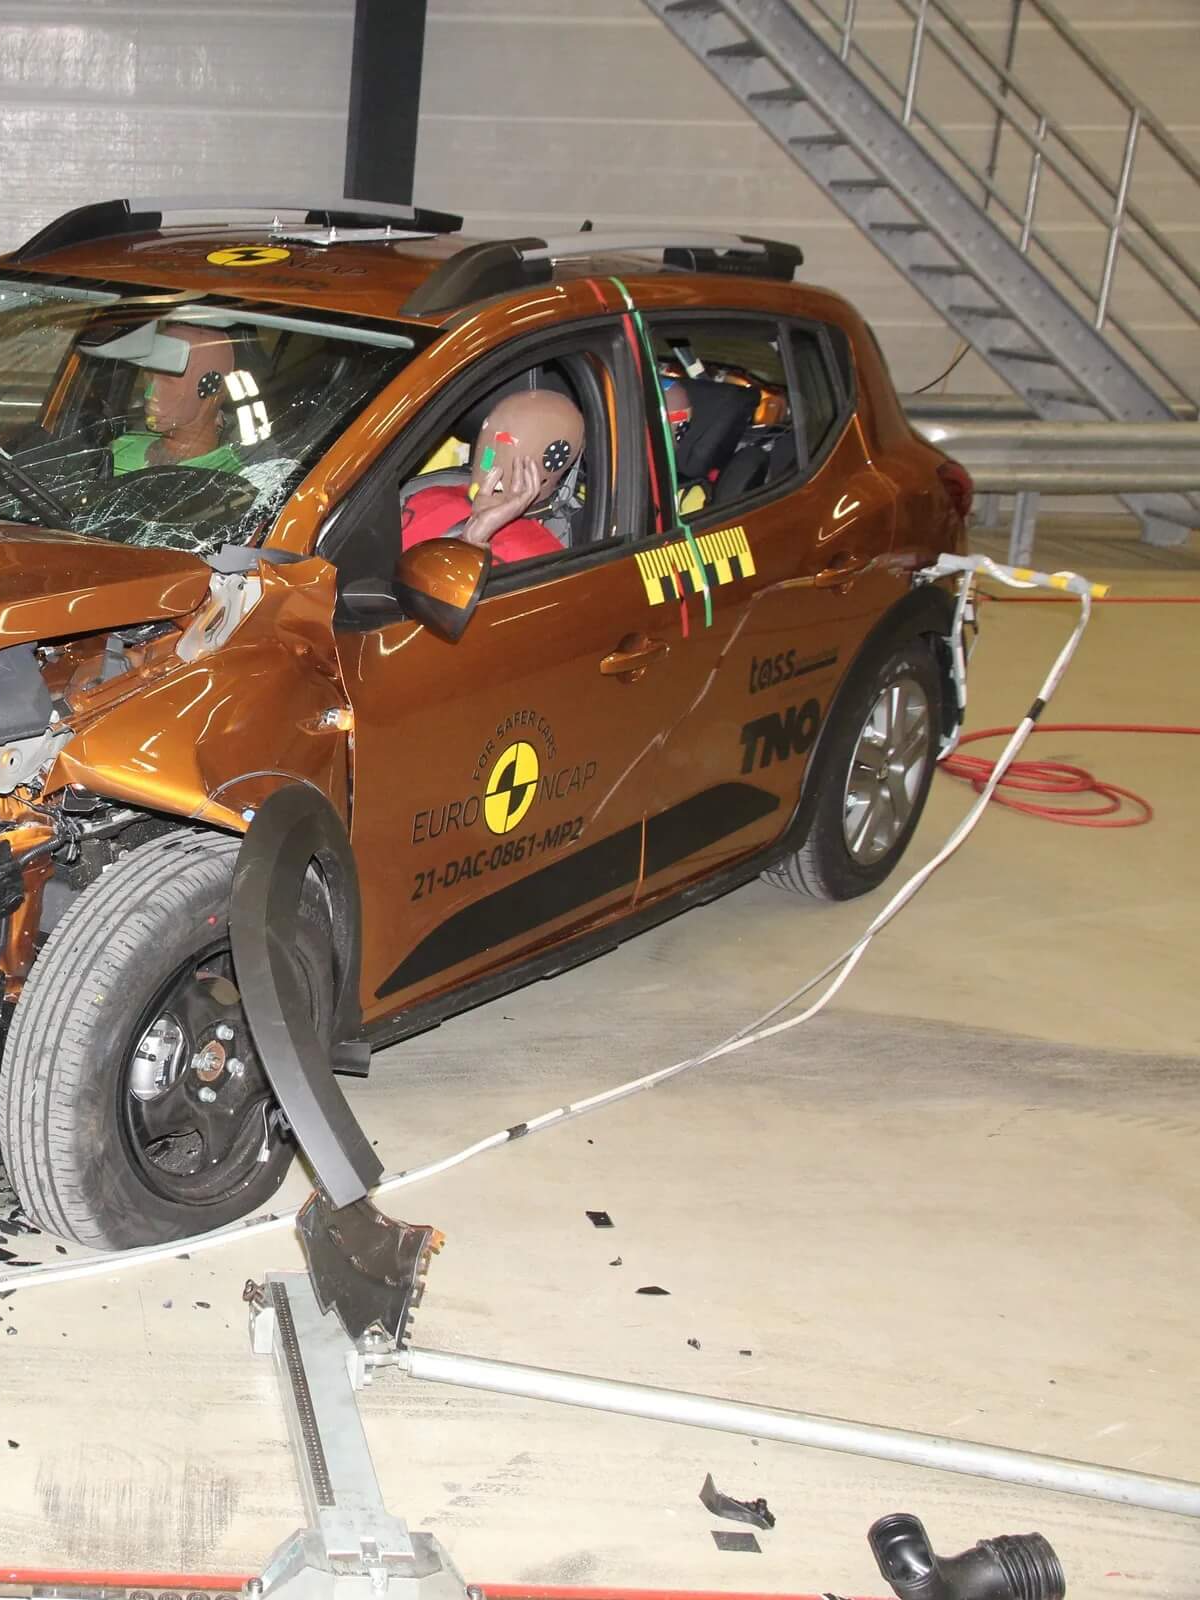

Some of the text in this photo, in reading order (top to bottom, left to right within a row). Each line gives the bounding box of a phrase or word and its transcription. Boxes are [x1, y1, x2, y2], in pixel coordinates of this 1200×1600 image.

[472, 710, 558, 781] FOR SAFER CARS
[740, 698, 820, 774] TNO
[411, 760, 597, 845] EURO NCAP
[411, 815, 584, 901] 21-DAC-0861-MP2
